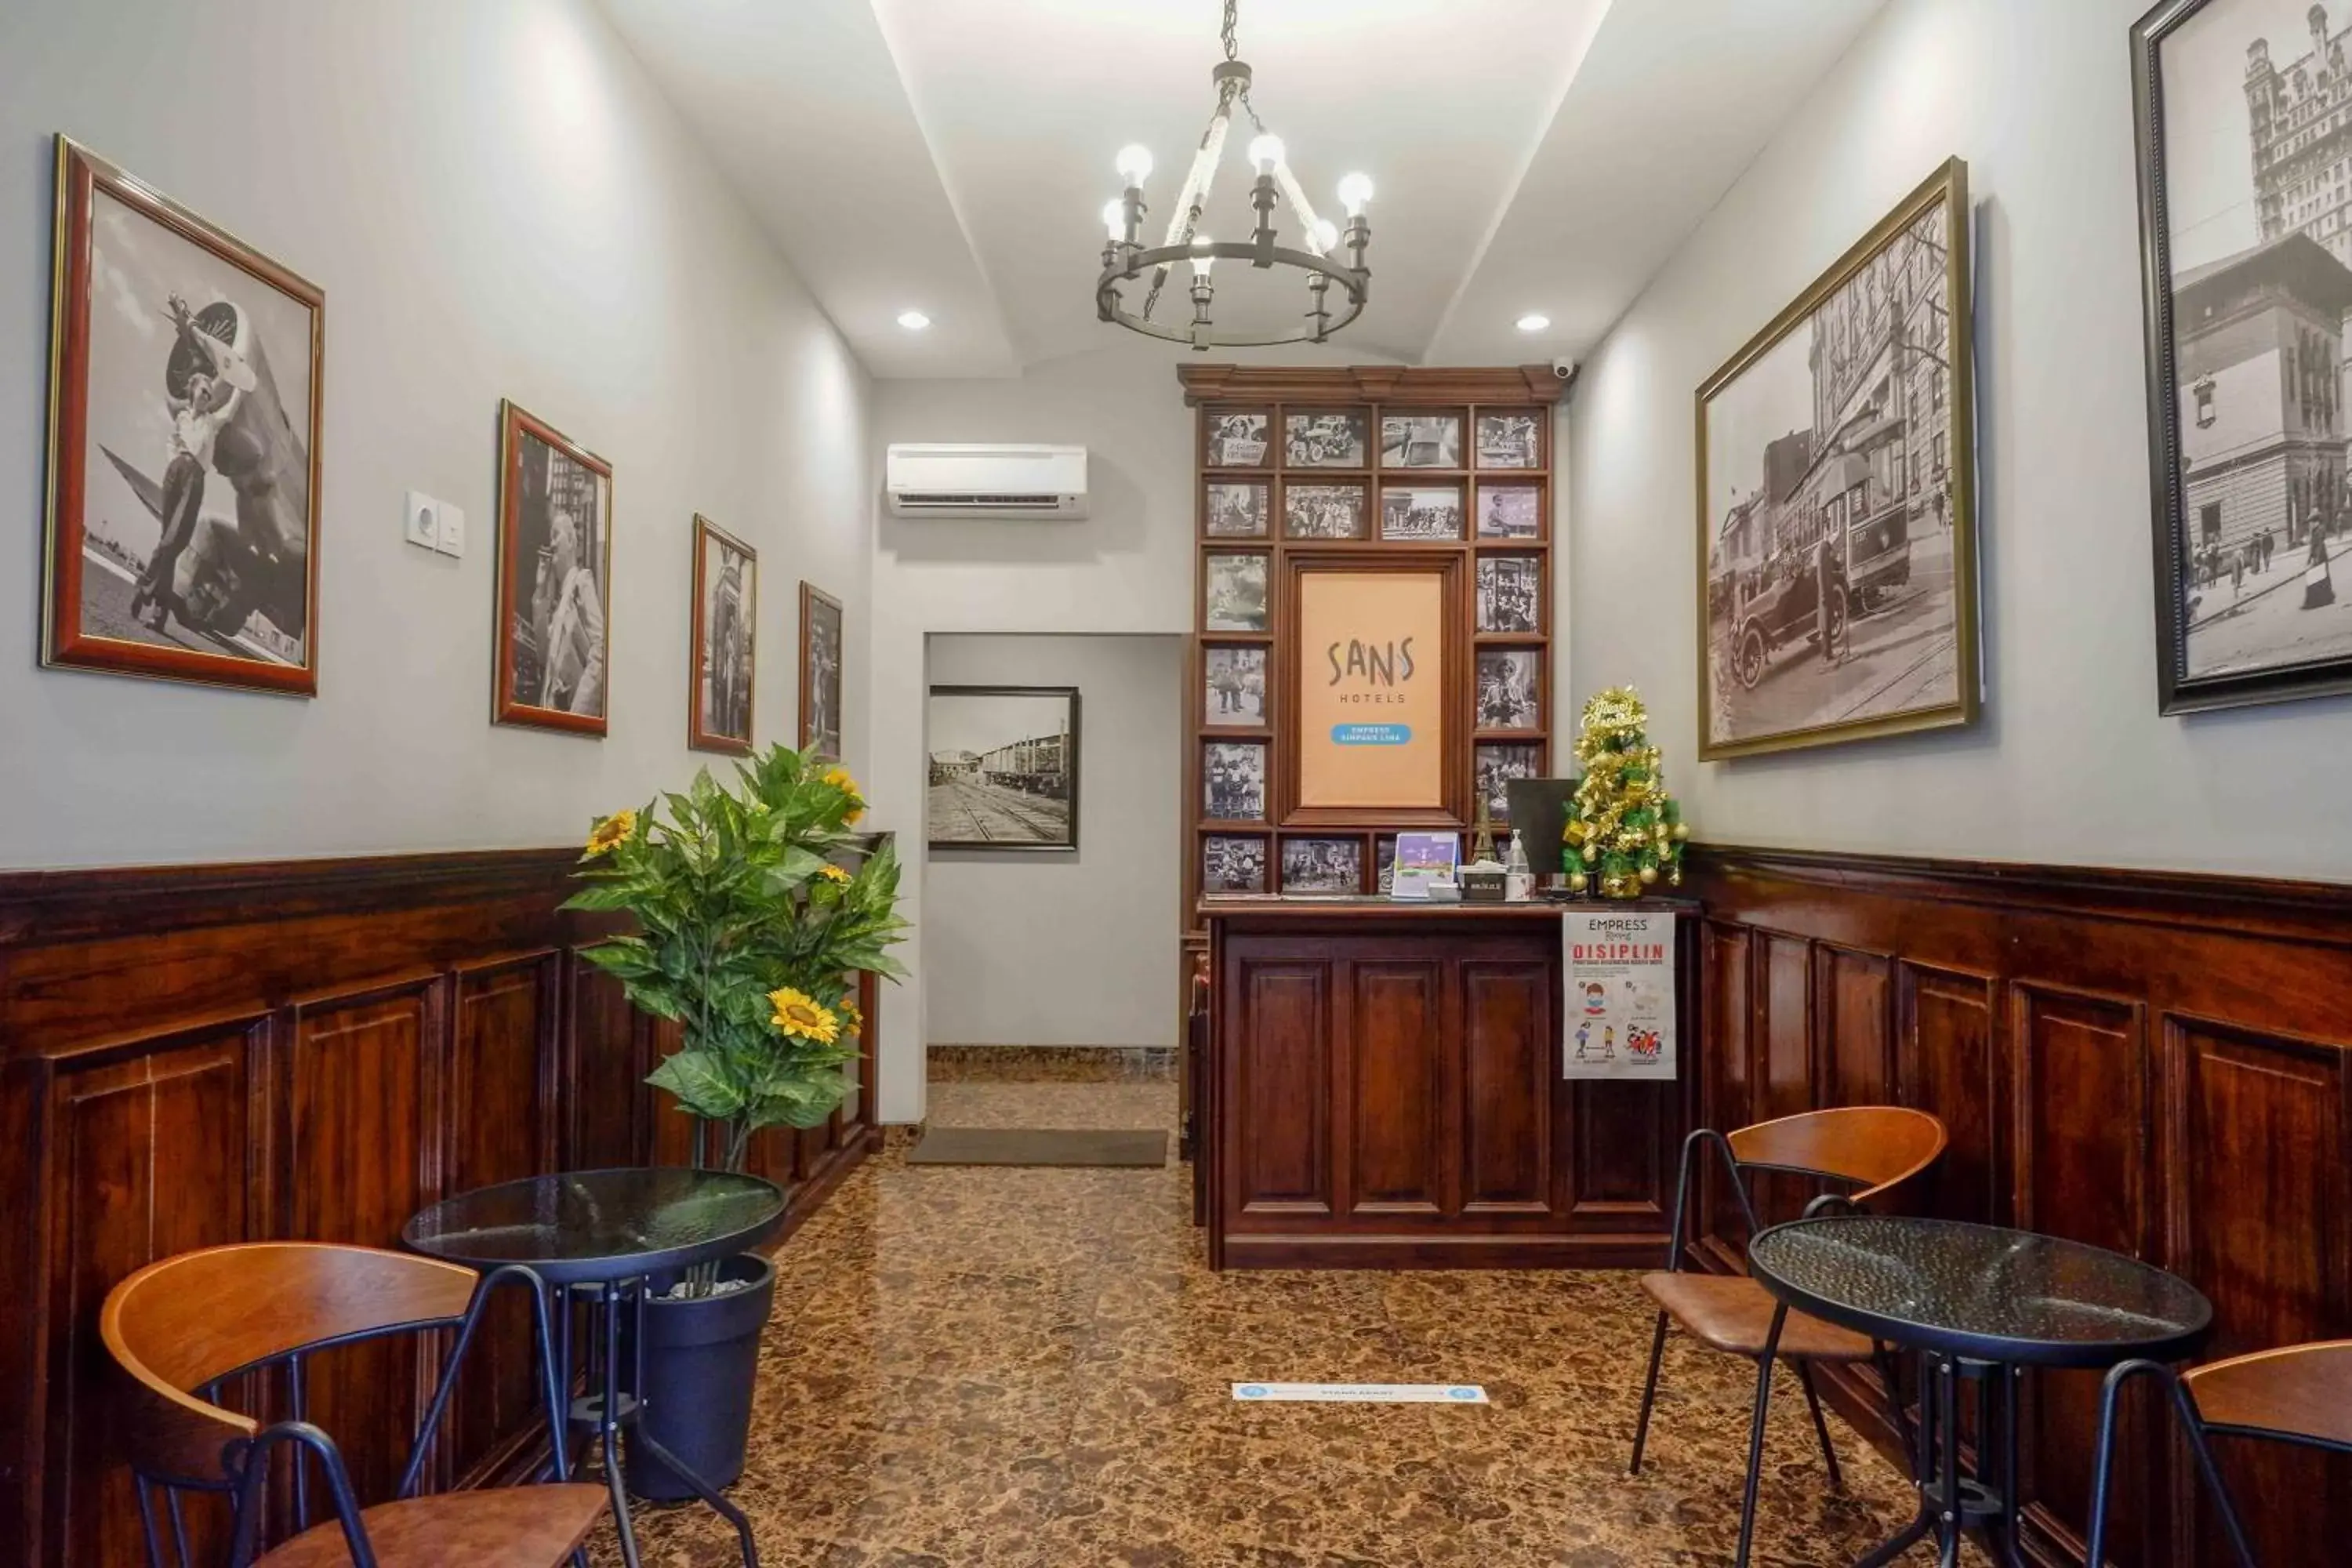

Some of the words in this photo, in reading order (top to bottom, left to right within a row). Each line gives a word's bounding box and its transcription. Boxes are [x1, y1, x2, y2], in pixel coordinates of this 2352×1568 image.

[1327, 637, 1415, 687] SANS
[1340, 694, 1406, 703] HOTELS
[1588, 919, 1648, 931] EMPRESS
[1573, 943, 1664, 959] DISIPLIN
